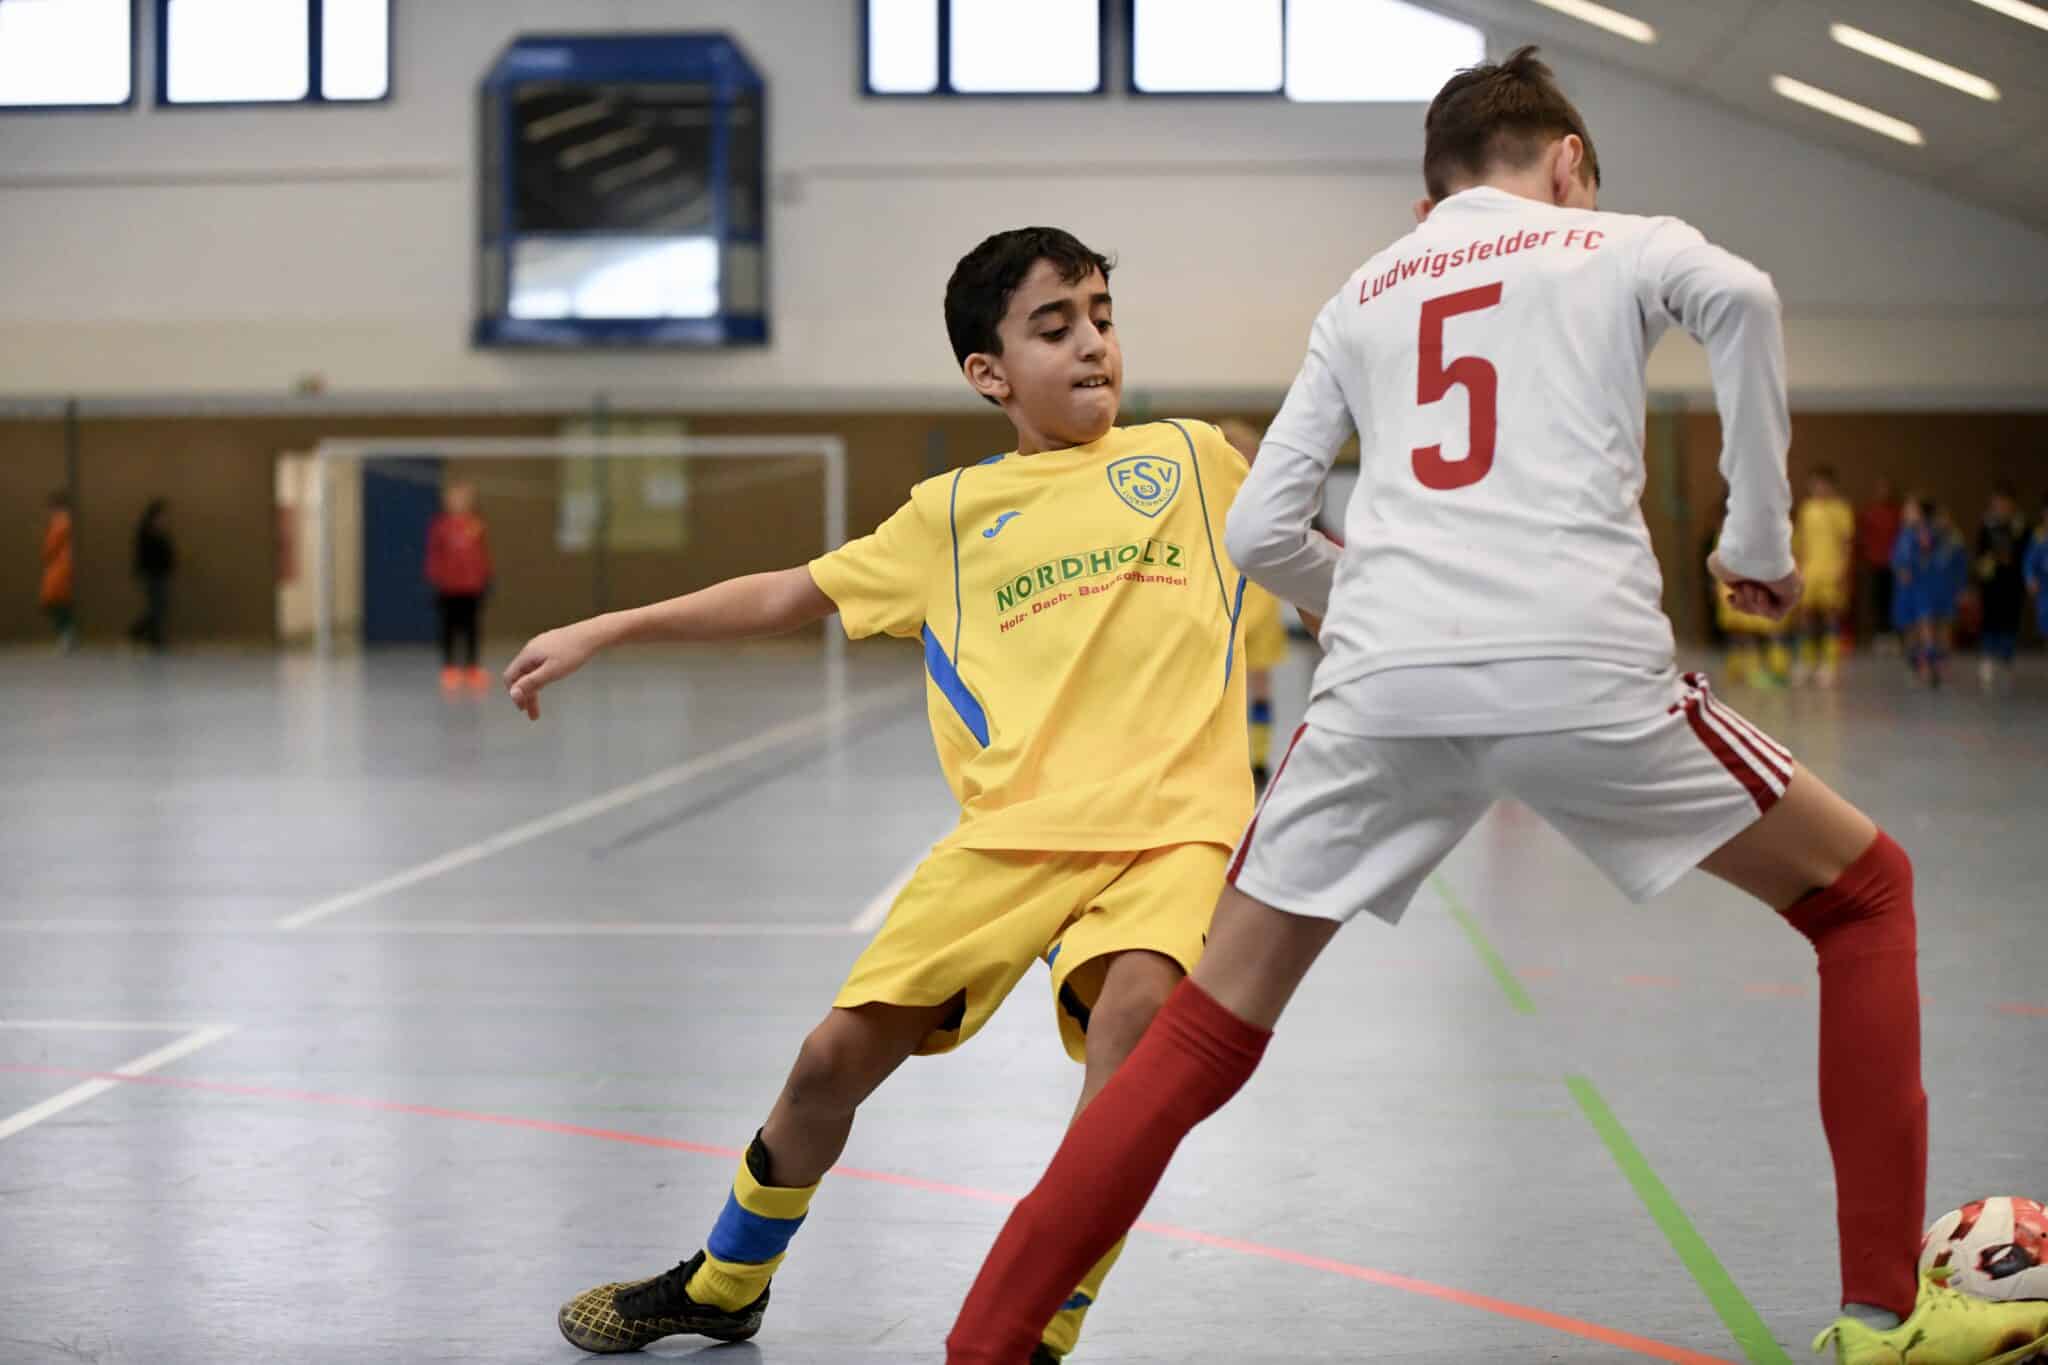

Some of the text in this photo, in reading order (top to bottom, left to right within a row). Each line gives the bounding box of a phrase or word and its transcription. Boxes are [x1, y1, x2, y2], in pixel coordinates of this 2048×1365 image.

[1359, 229, 1605, 304] Ludwigsfelder FC
[1411, 281, 1503, 490] 5
[1117, 461, 1172, 500] FSV
[996, 539, 1182, 612] NORDHOLZ
[1000, 611, 1028, 633] Holz-
[1031, 591, 1073, 615] Dach-
